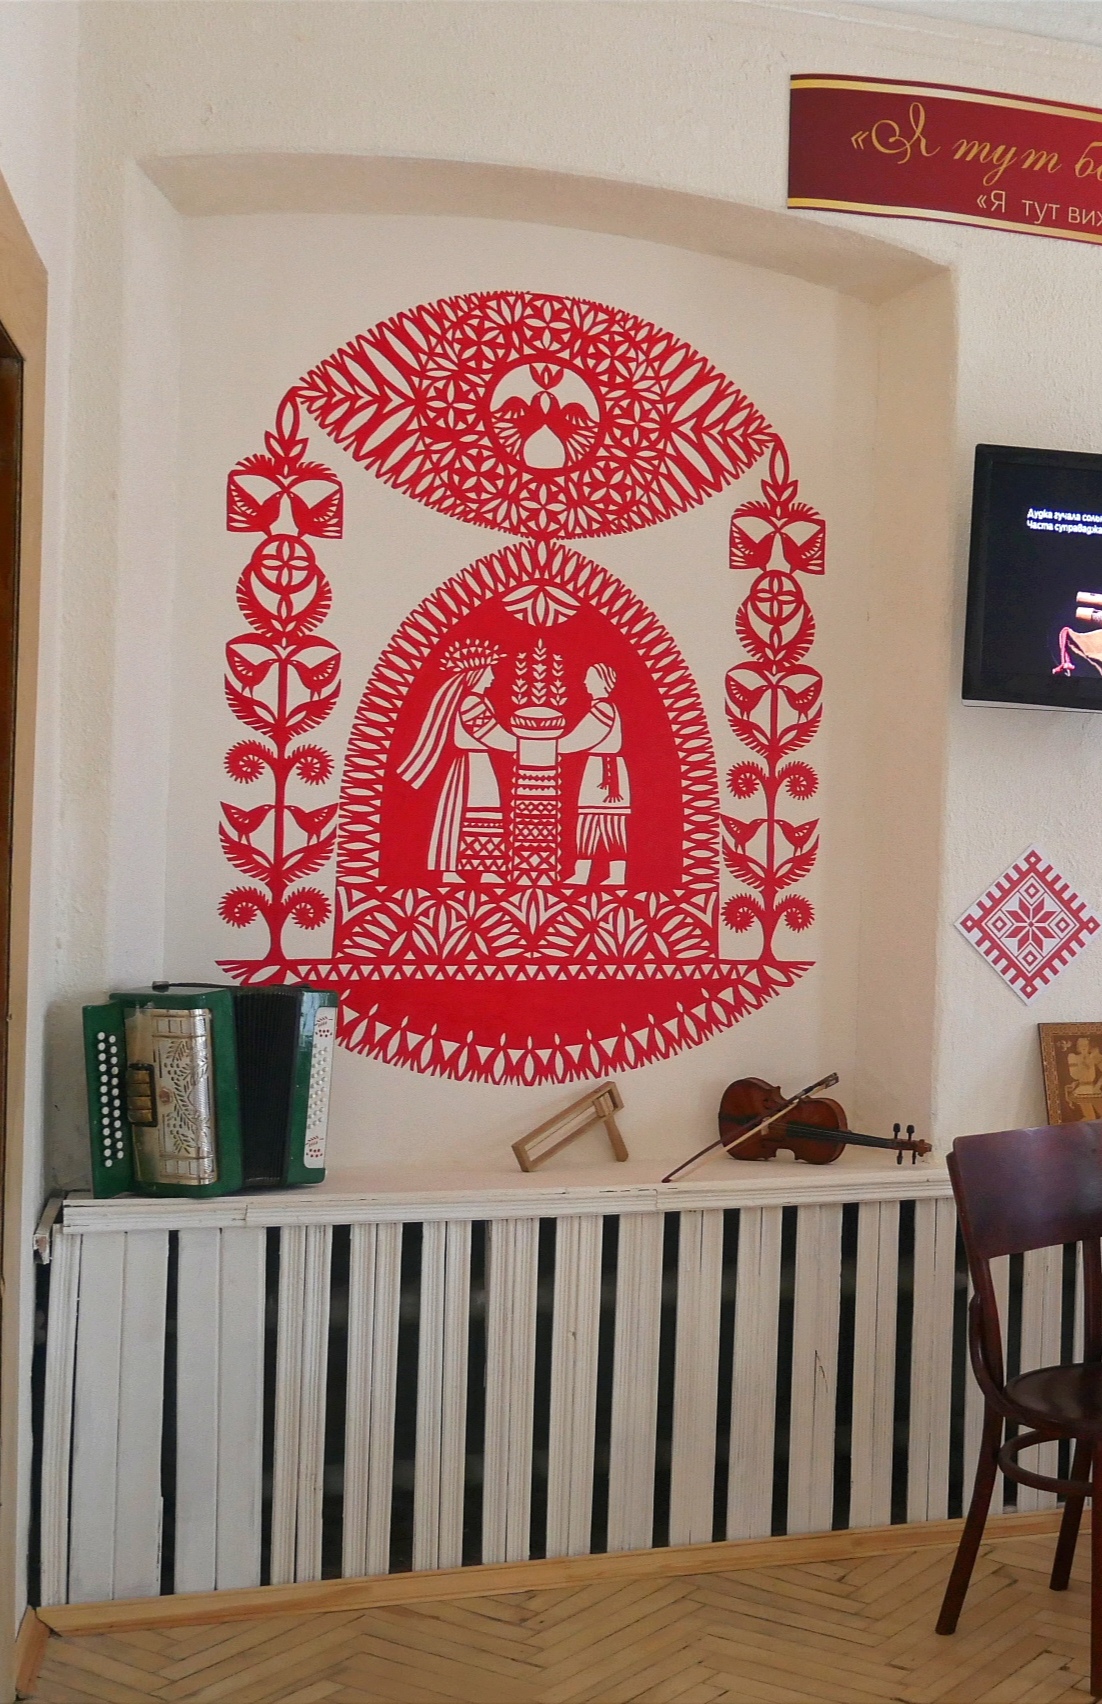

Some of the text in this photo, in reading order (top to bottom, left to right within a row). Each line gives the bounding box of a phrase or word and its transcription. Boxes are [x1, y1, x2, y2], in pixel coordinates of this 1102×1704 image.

[851, 102, 941, 164] «Я
[952, 138, 1062, 186] тут
[976, 189, 1006, 213] «Я
[1022, 199, 1060, 223] тут
[1027, 508, 1053, 520] Дудка
[1027, 519, 1054, 531] Часта
